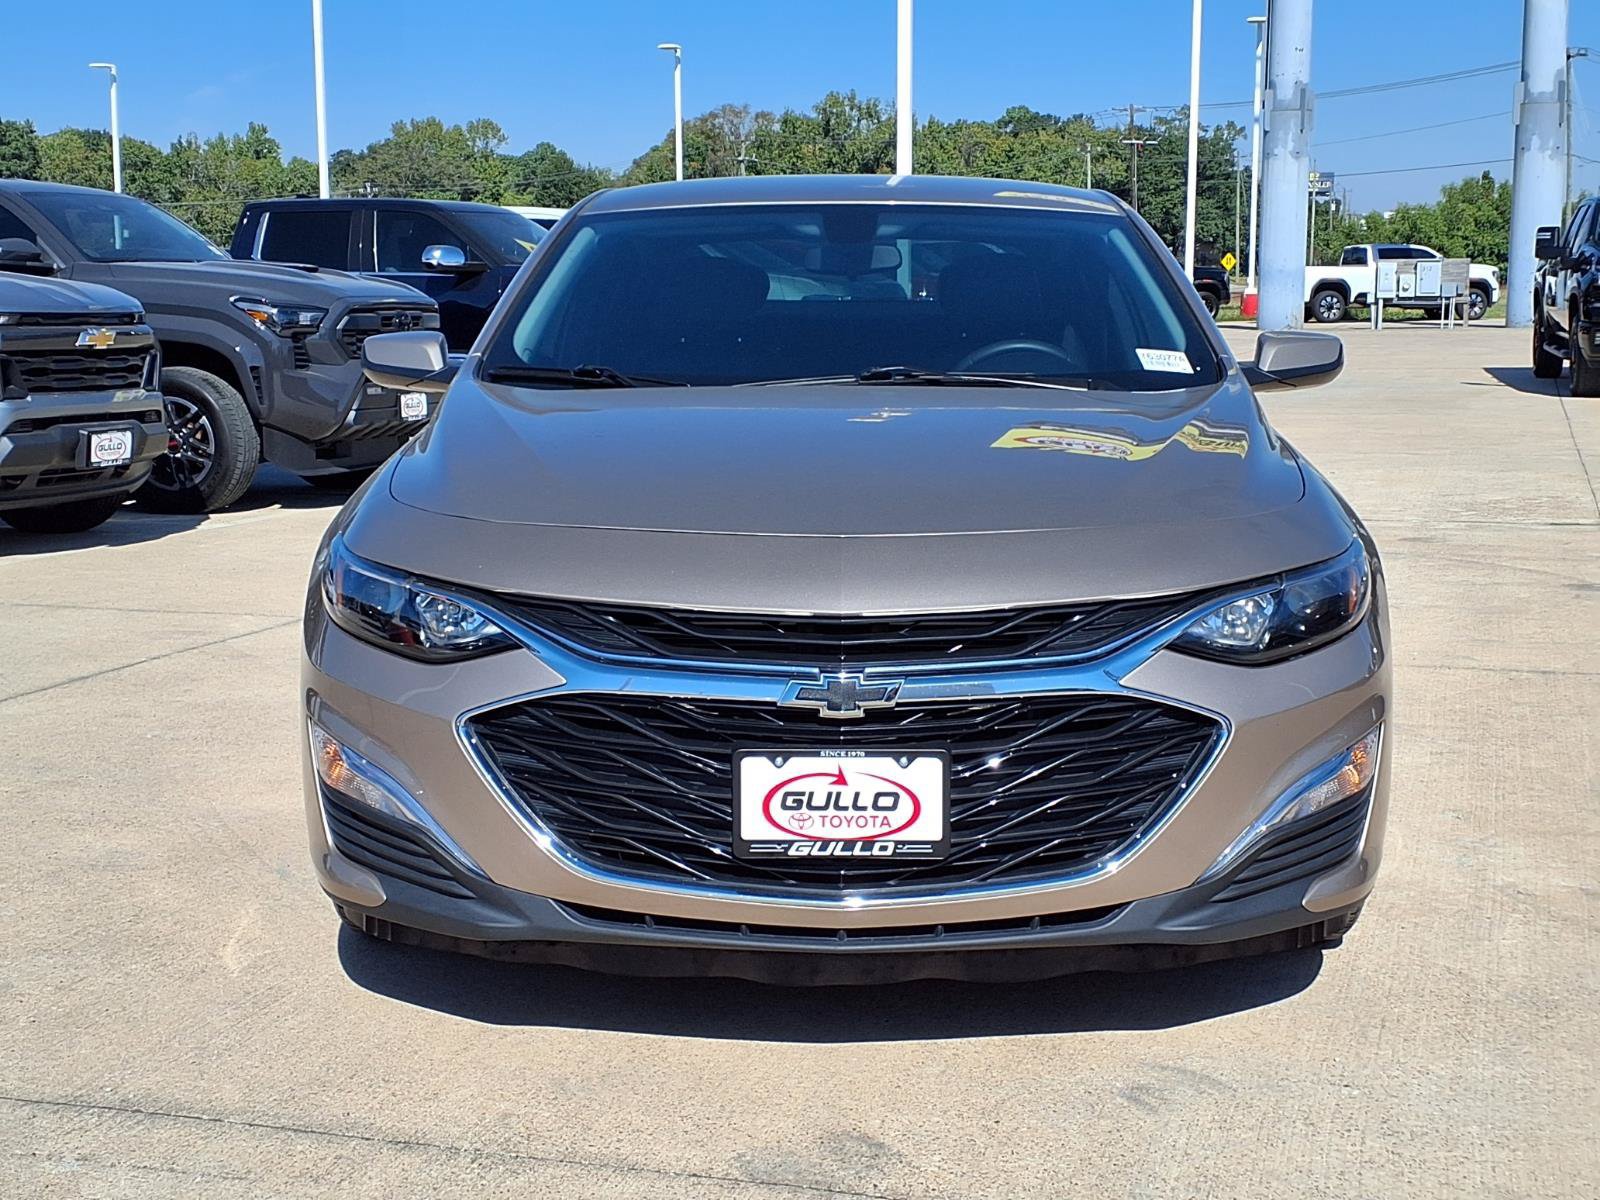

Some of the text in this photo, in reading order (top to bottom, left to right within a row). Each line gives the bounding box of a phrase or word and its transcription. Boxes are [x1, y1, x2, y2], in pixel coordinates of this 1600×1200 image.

[98, 443, 123, 452] GULLO
[780, 791, 900, 812] GULLO
[819, 815, 892, 828] TOYOTA
[787, 841, 895, 856] GULLO
